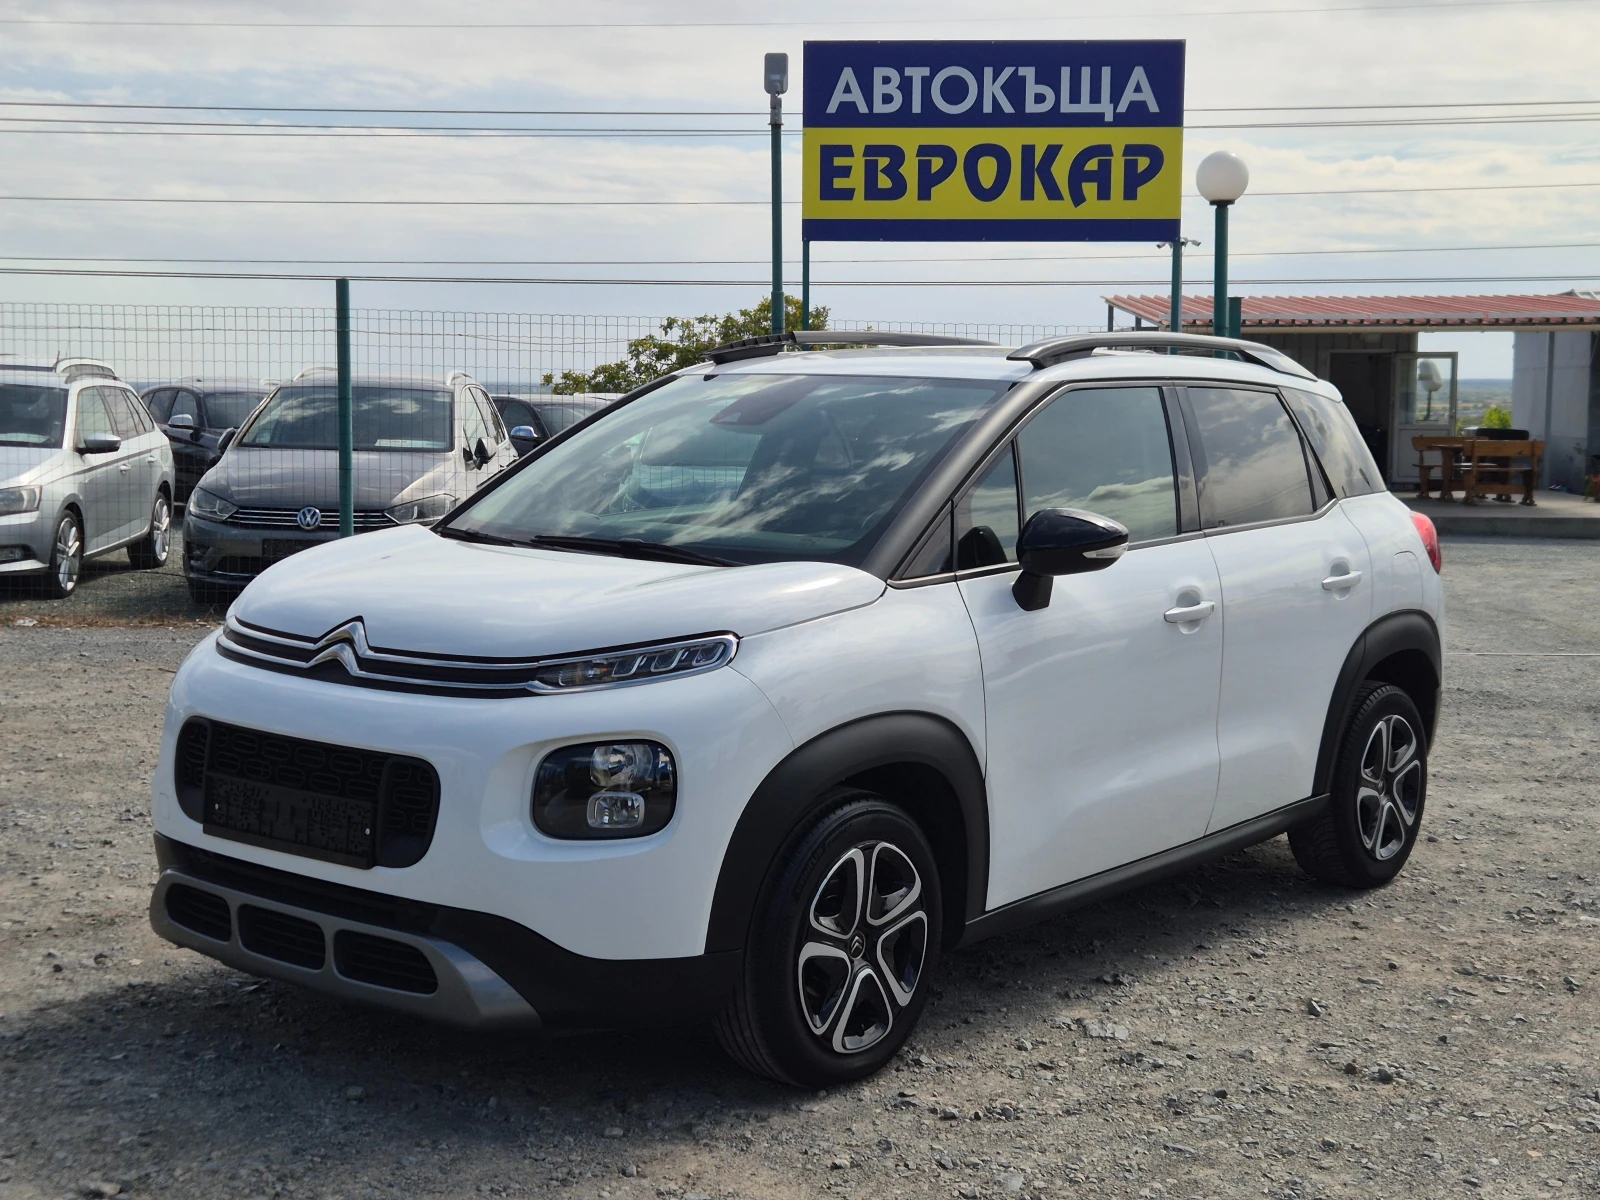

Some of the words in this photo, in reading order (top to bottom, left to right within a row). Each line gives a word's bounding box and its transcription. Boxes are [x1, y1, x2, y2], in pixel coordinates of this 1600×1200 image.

[825, 65, 1160, 122] АВТОКЪЩА
[819, 142, 1165, 209] ЕВРОКАР
[297, 507, 321, 530] VW
